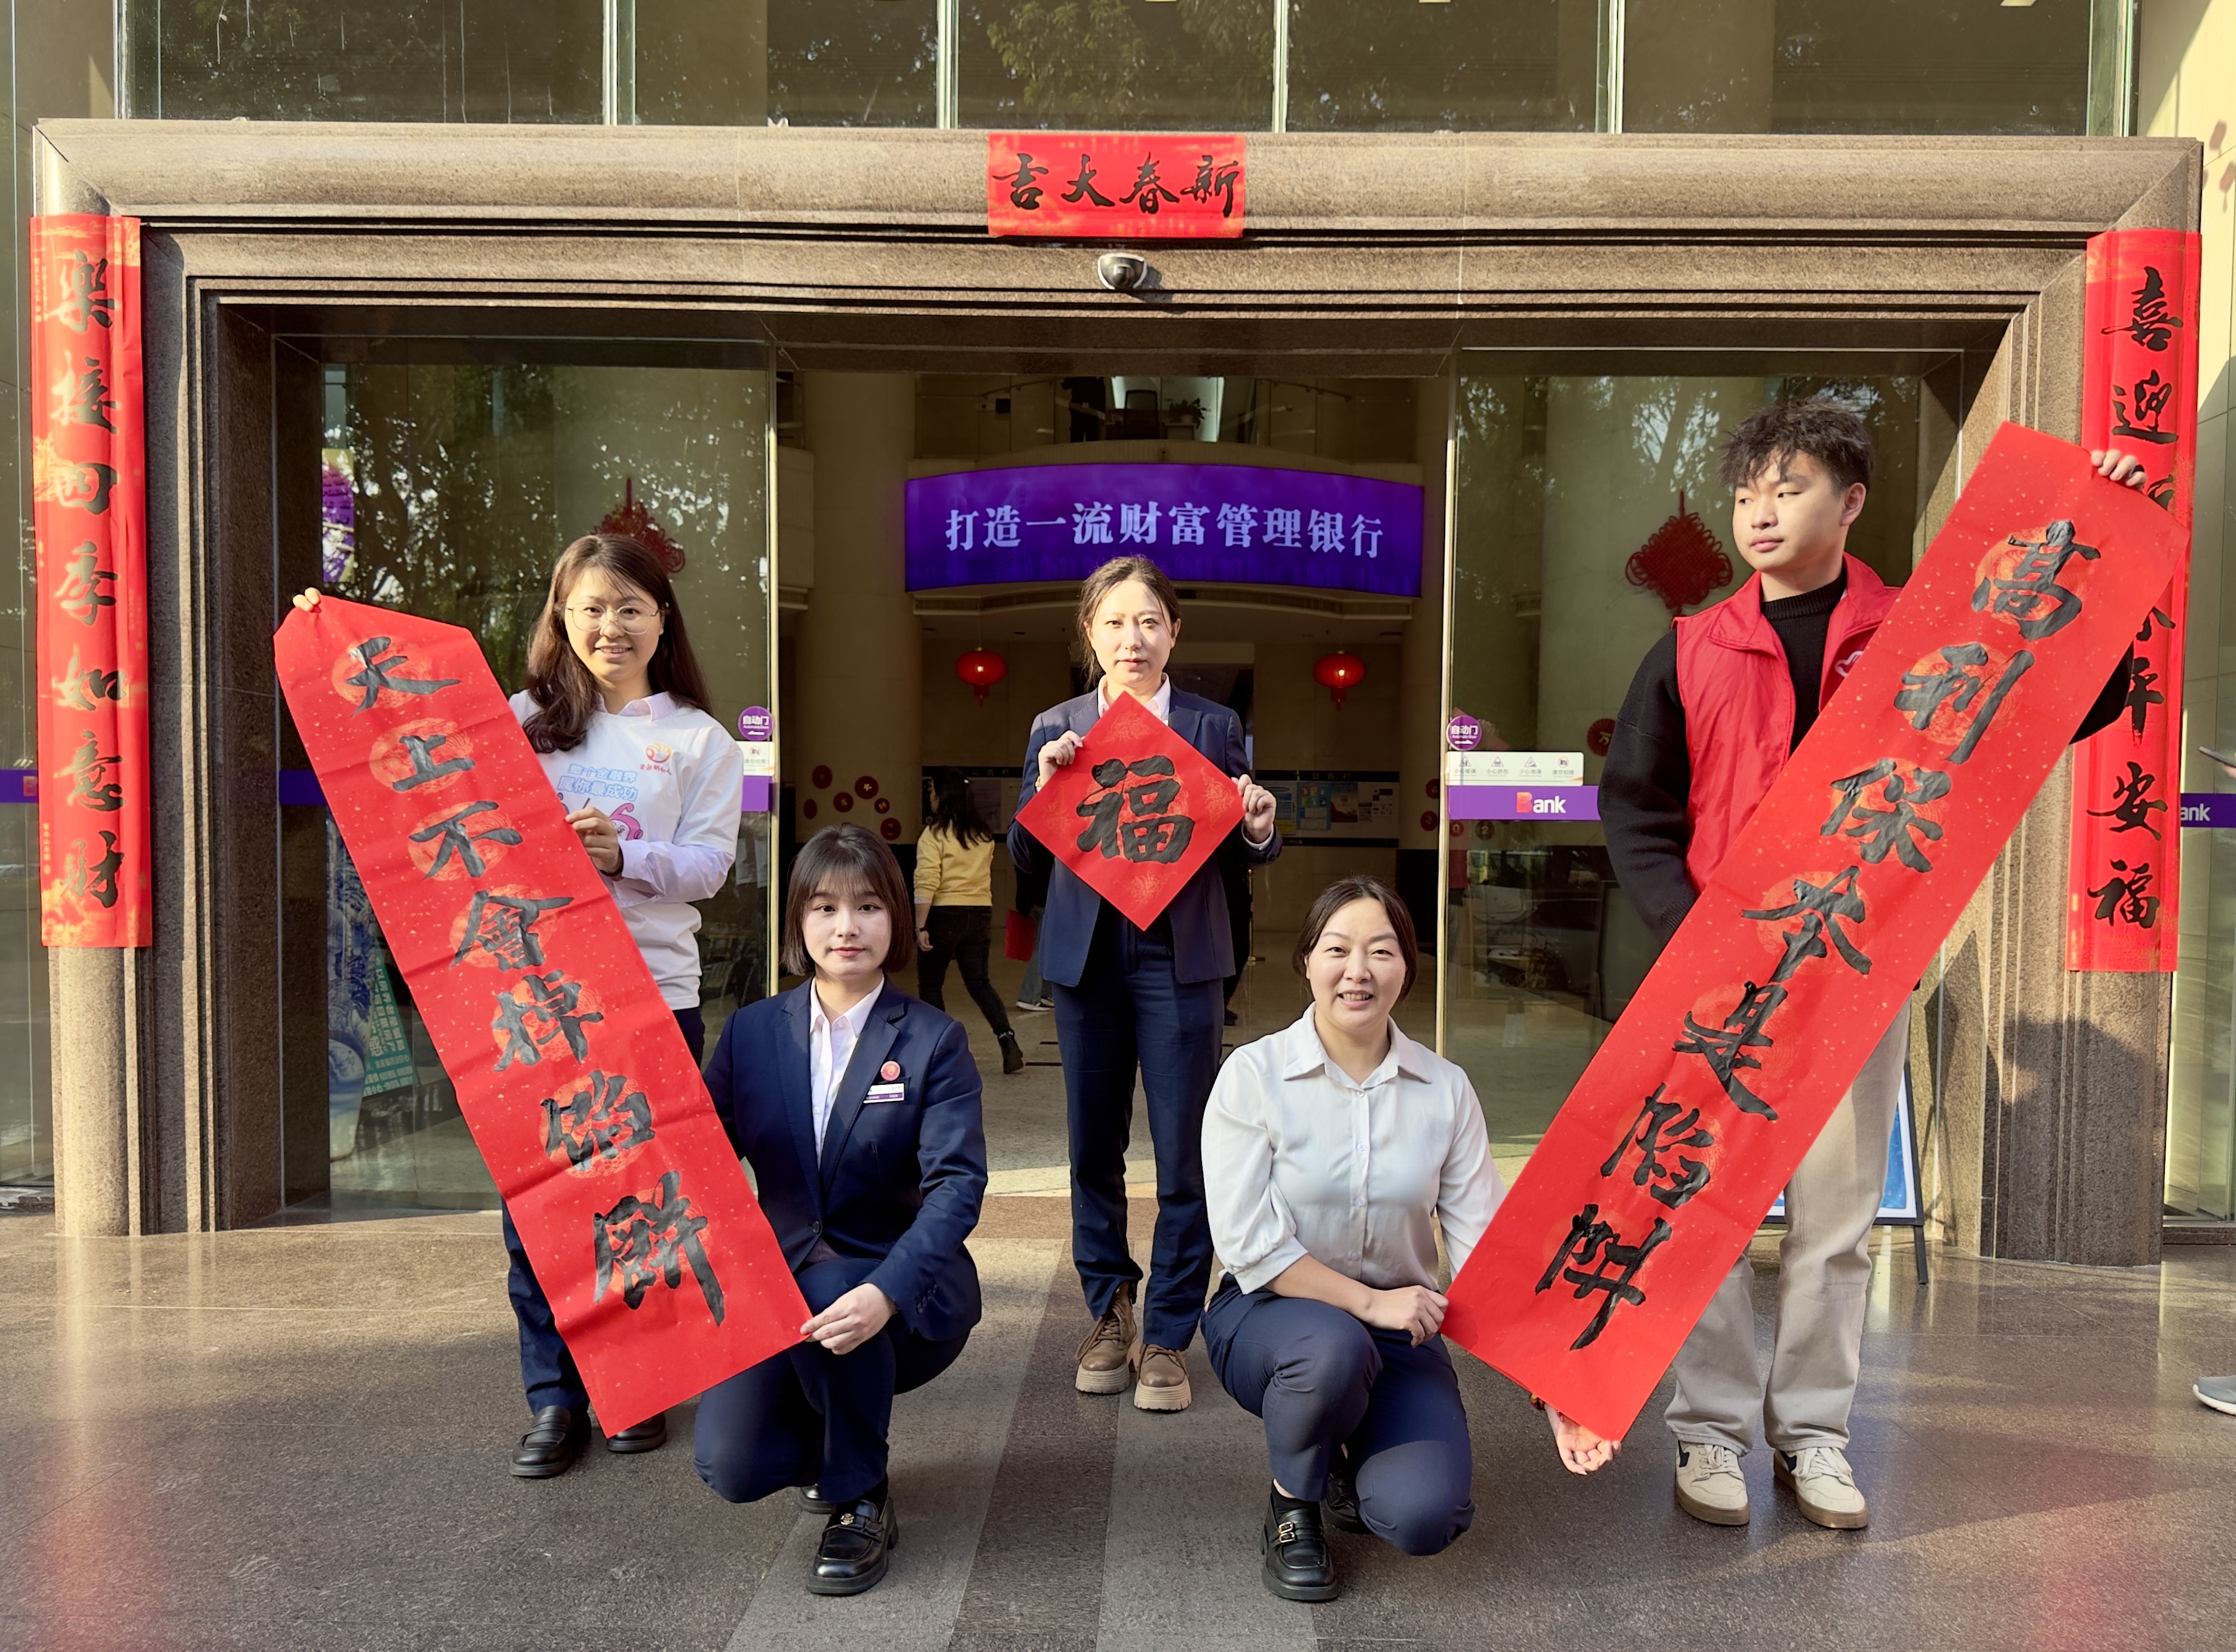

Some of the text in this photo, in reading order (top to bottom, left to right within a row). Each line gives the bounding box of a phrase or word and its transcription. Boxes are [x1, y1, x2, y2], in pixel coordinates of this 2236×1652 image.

[945, 501, 1384, 559] 打造一流财富管理银行
[2086, 266, 2184, 929] 喜迎平安福
[742, 715, 770, 725] 自动门
[1451, 724, 1479, 735] 自动门
[567, 763, 638, 784] 整个金融界
[556, 775, 638, 801] 属你最成功
[1076, 755, 1196, 864] 福
[1516, 791, 1567, 814] Bank
[2180, 803, 2211, 822] ank
